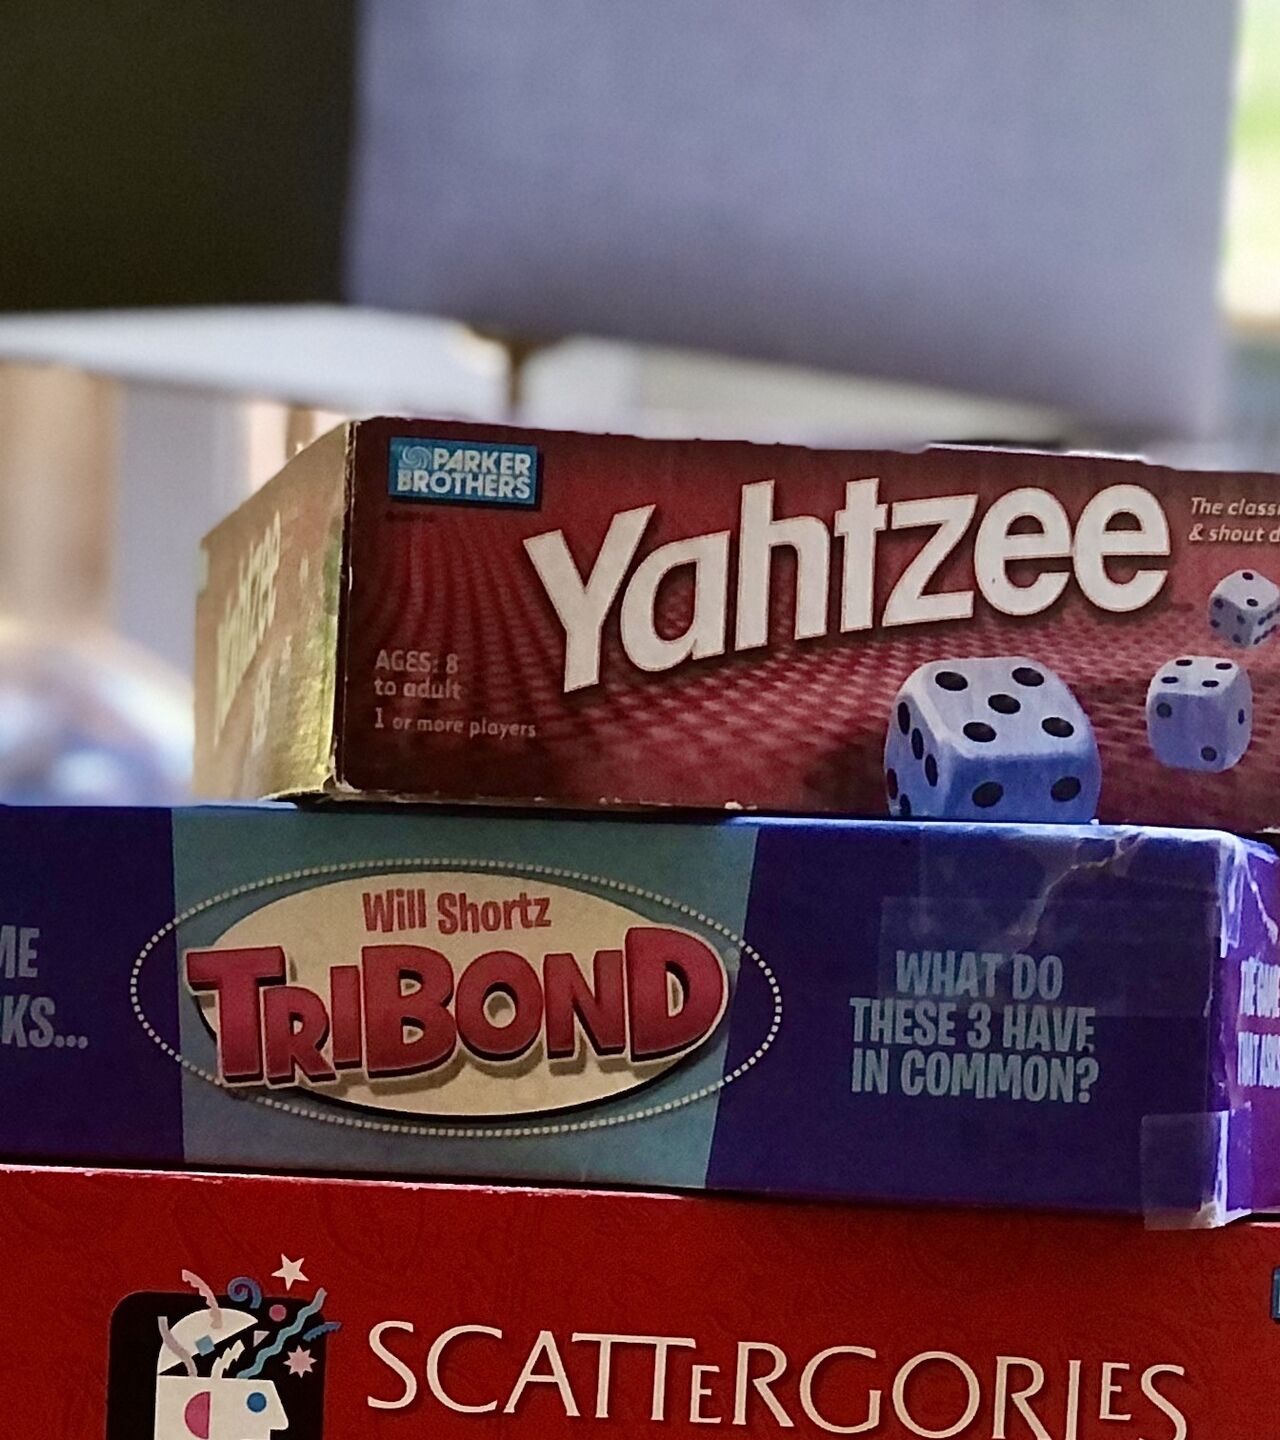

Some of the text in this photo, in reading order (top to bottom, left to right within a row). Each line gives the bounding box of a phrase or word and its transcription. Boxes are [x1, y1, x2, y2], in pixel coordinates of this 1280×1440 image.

[433, 448, 531, 476] PARKER
[397, 469, 531, 499] BROTHERS
[1190, 497, 1221, 515] The
[1188, 523, 1203, 542] &
[1208, 524, 1264, 543] shout
[523, 477, 1170, 693] Yahtzee
[375, 650, 459, 673] AGES: 8
[375, 677, 463, 700] to adult
[375, 707, 536, 739] 1 or more players
[363, 888, 551, 934] Will Shortz
[896, 950, 1063, 999] WHAT DO
[850, 997, 1096, 1052] THESE 3 HAVE
[851, 1048, 1099, 1103] IN COMMON?
